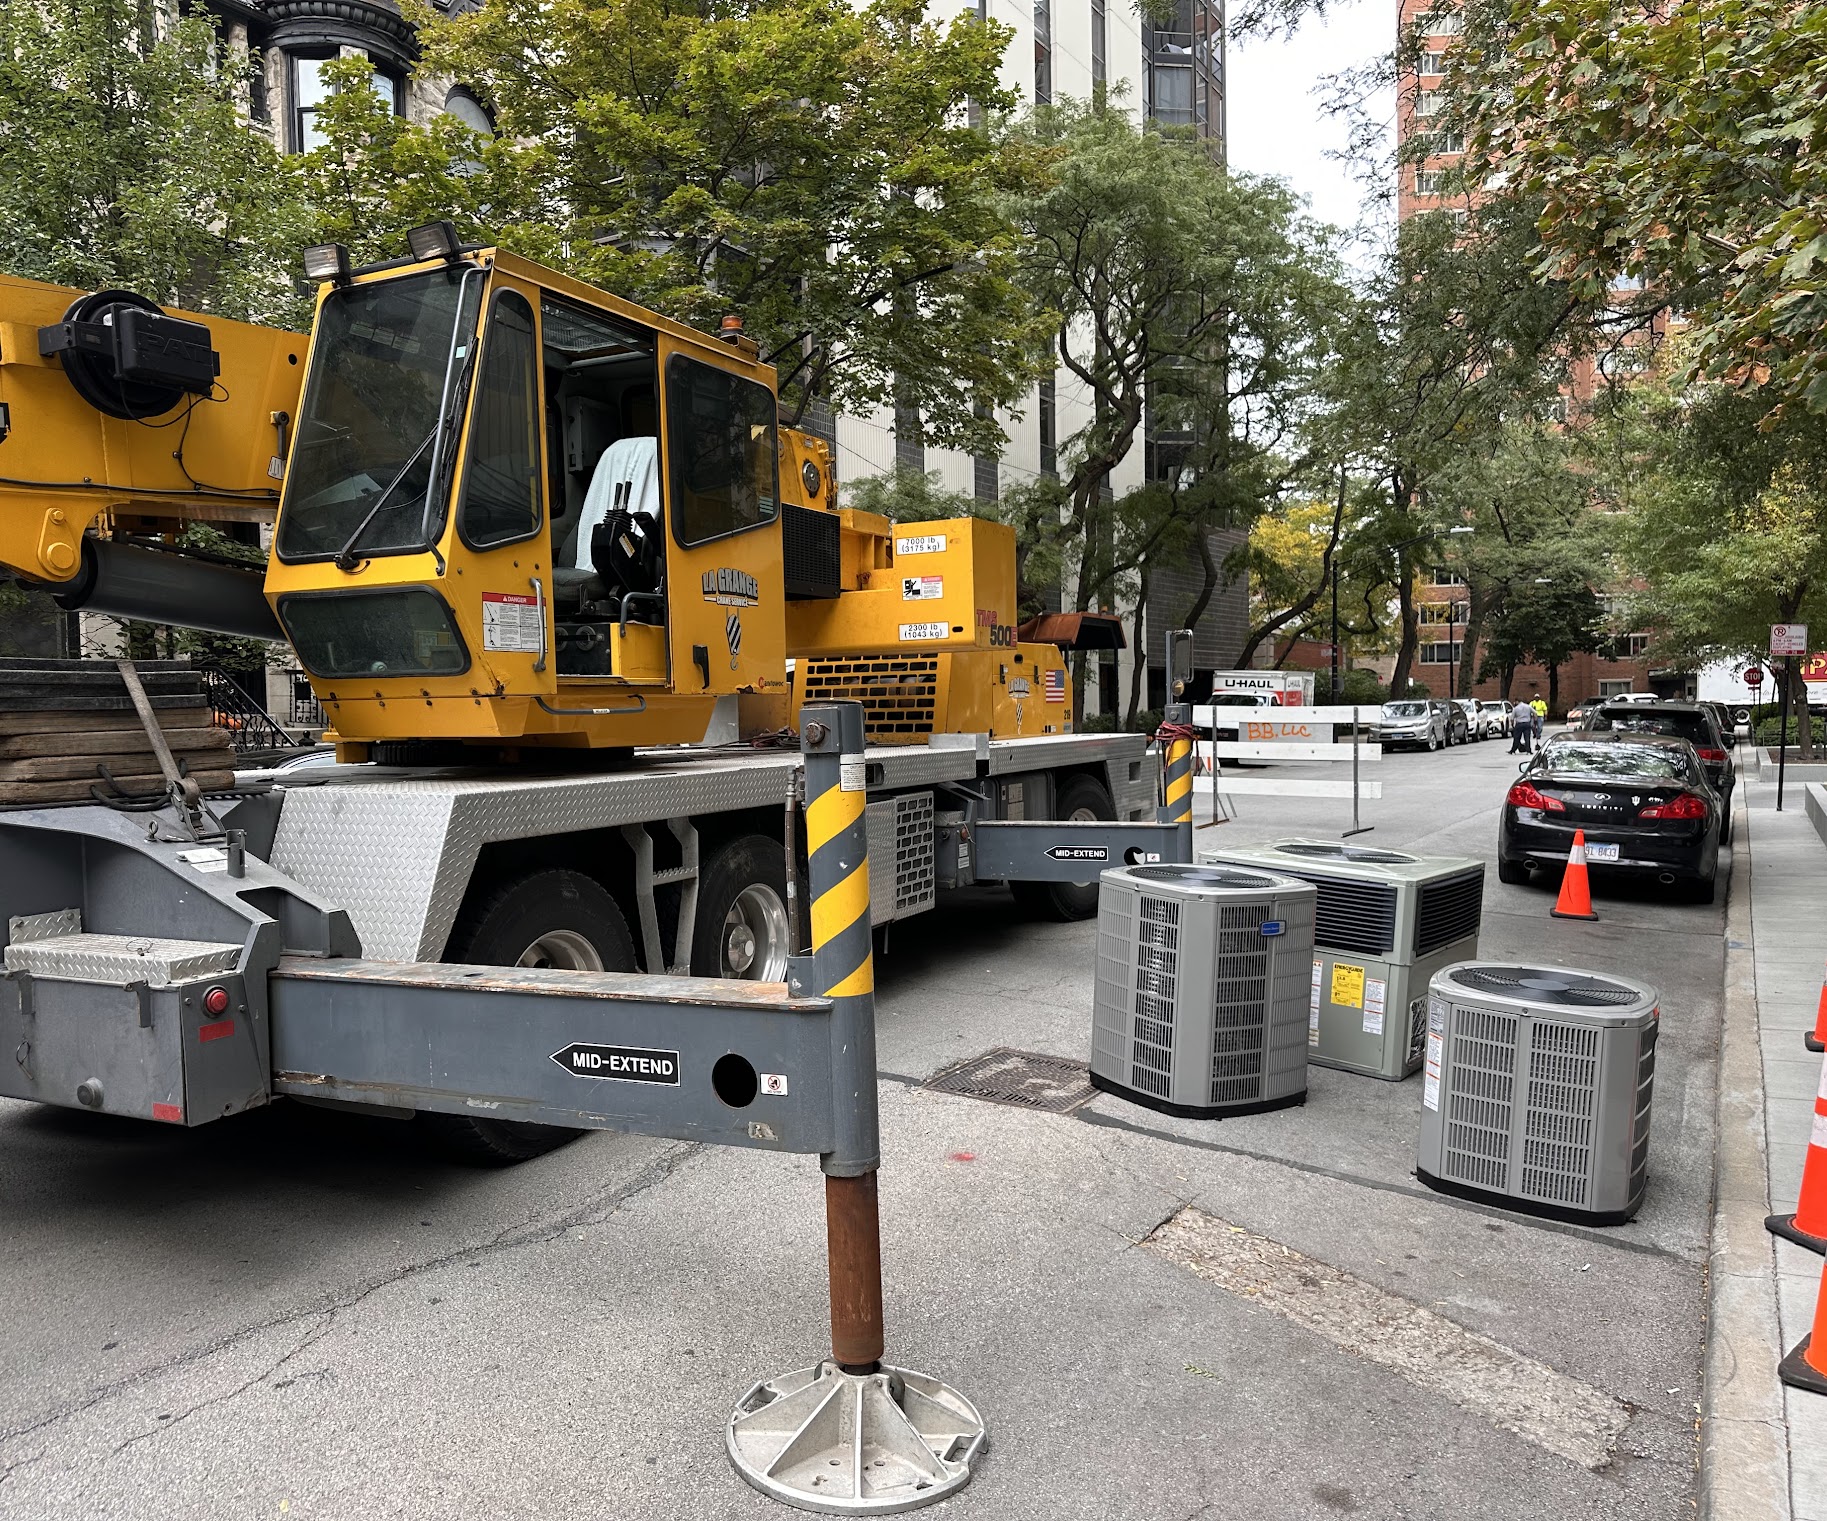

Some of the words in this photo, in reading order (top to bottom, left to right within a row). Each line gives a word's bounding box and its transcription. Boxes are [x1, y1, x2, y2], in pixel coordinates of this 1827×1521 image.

[901, 544, 925, 553] (3175
[927, 541, 940, 552] kg)
[702, 570, 716, 595] LA
[717, 567, 758, 601] GRANGE
[976, 609, 997, 627] TMS
[904, 631, 927, 639] (1043
[929, 628, 943, 638] kg)
[990, 624, 1018, 648] 500E
[1225, 679, 1274, 689] U-HAUL
[1055, 849, 1106, 858] MID-EXTEND
[572, 1051, 674, 1076] MID-EXTEND
